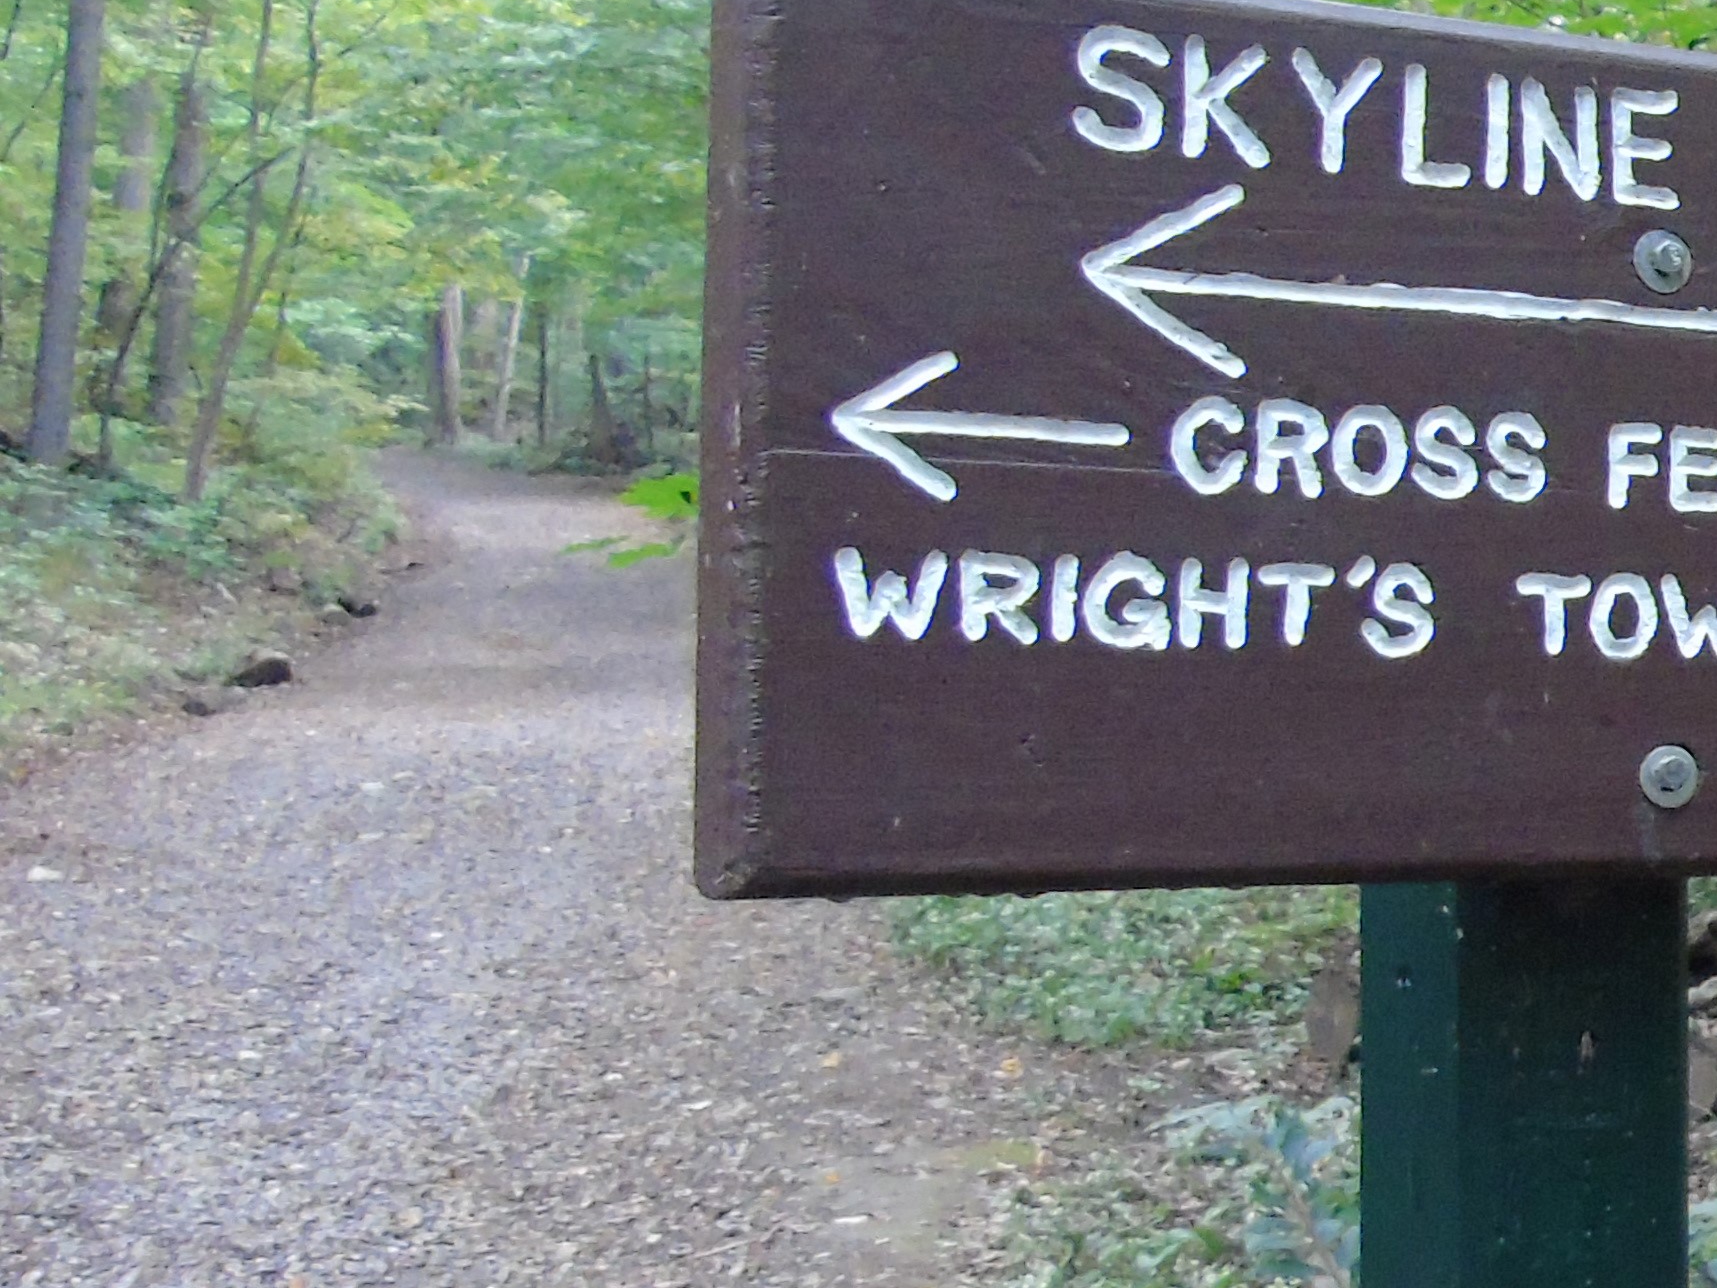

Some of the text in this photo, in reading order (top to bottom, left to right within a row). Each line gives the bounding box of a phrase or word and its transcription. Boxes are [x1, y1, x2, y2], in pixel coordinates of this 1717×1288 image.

[1072, 23, 1682, 212] SKYLINE
[1170, 396, 1545, 502] CROSS
[834, 548, 1433, 658] WRIGHT'S
